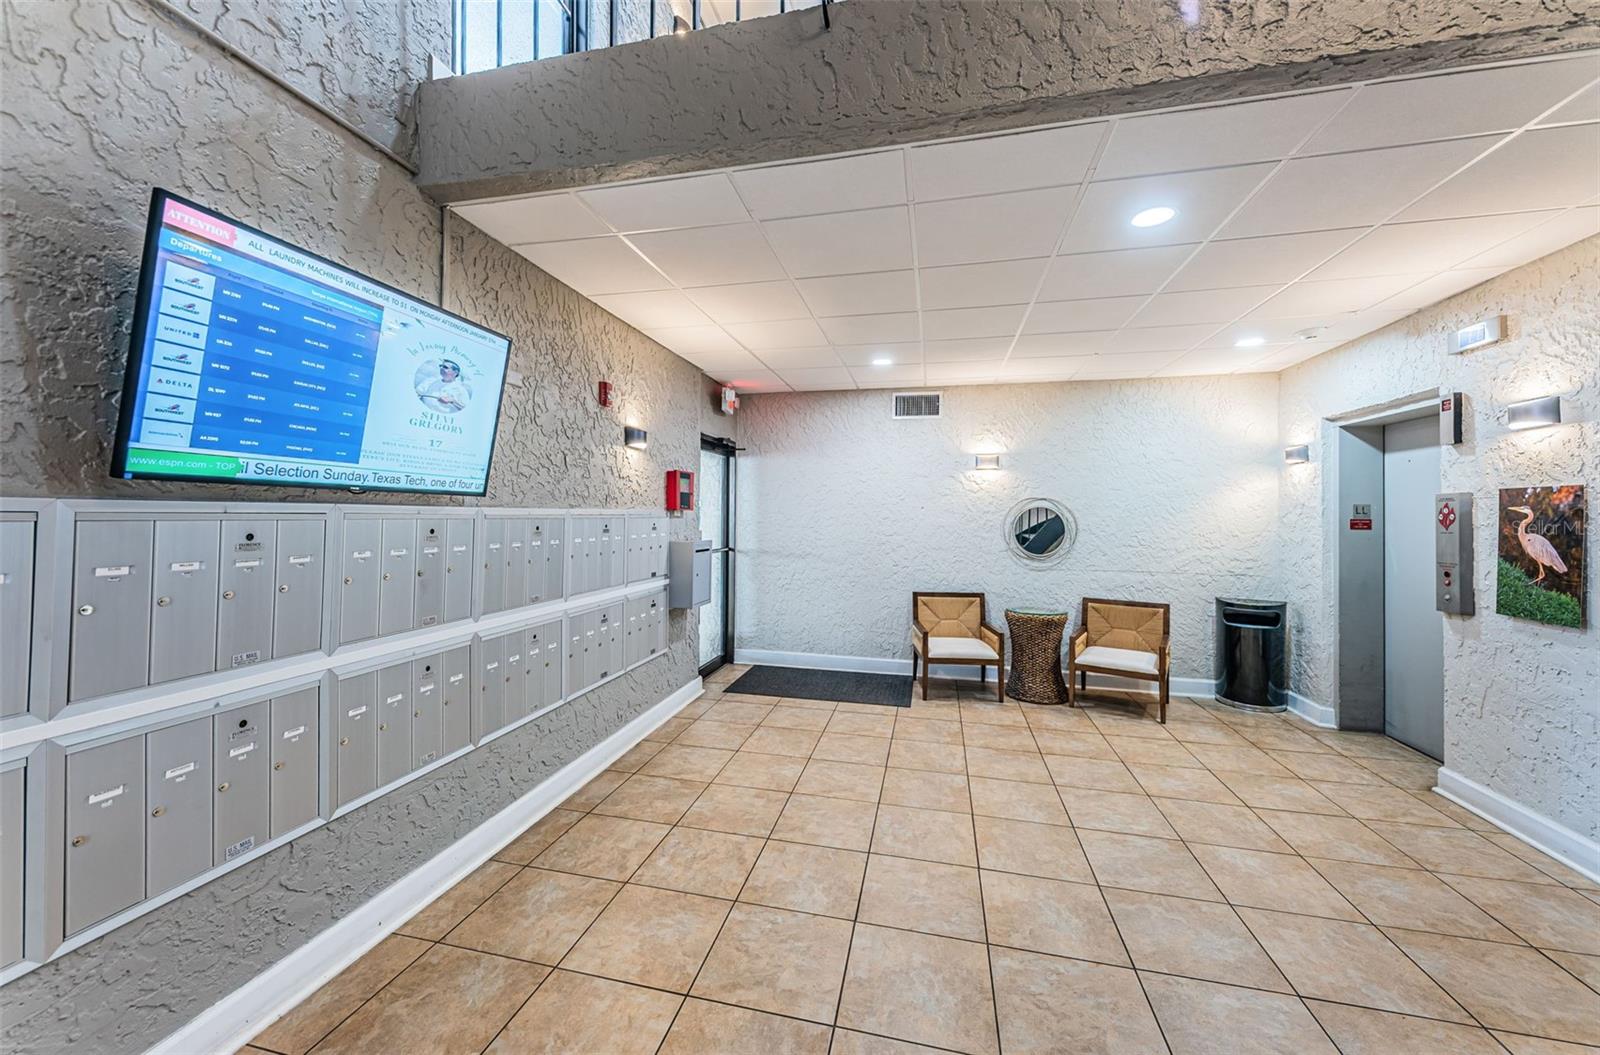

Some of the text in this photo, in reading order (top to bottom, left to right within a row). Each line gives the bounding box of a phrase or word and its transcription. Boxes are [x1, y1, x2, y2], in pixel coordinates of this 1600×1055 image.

[168, 209, 230, 240] ATTENTION
[170, 237, 222, 262] Departures
[248, 240, 264, 252] ALL
[269, 248, 306, 268] LAUNDRY
[307, 263, 344, 284] MACHINES
[344, 278, 360, 291] WILL
[361, 286, 391, 303] INCREASE
[392, 297, 400, 306] TO
[409, 306, 420, 314] ON
[164, 326, 192, 336] UNITED
[165, 379, 192, 388] DELTA
[409, 418, 463, 434] GREGORY
[429, 439, 443, 448] 17
[130, 456, 206, 470] www.espn.com
[215, 462, 236, 471] TOP
[254, 462, 318, 479] Selection
[430, 478, 446, 488] one
[448, 477, 458, 488] of
[458, 478, 474, 489] four
[1355, 506, 1368, 514] LL
